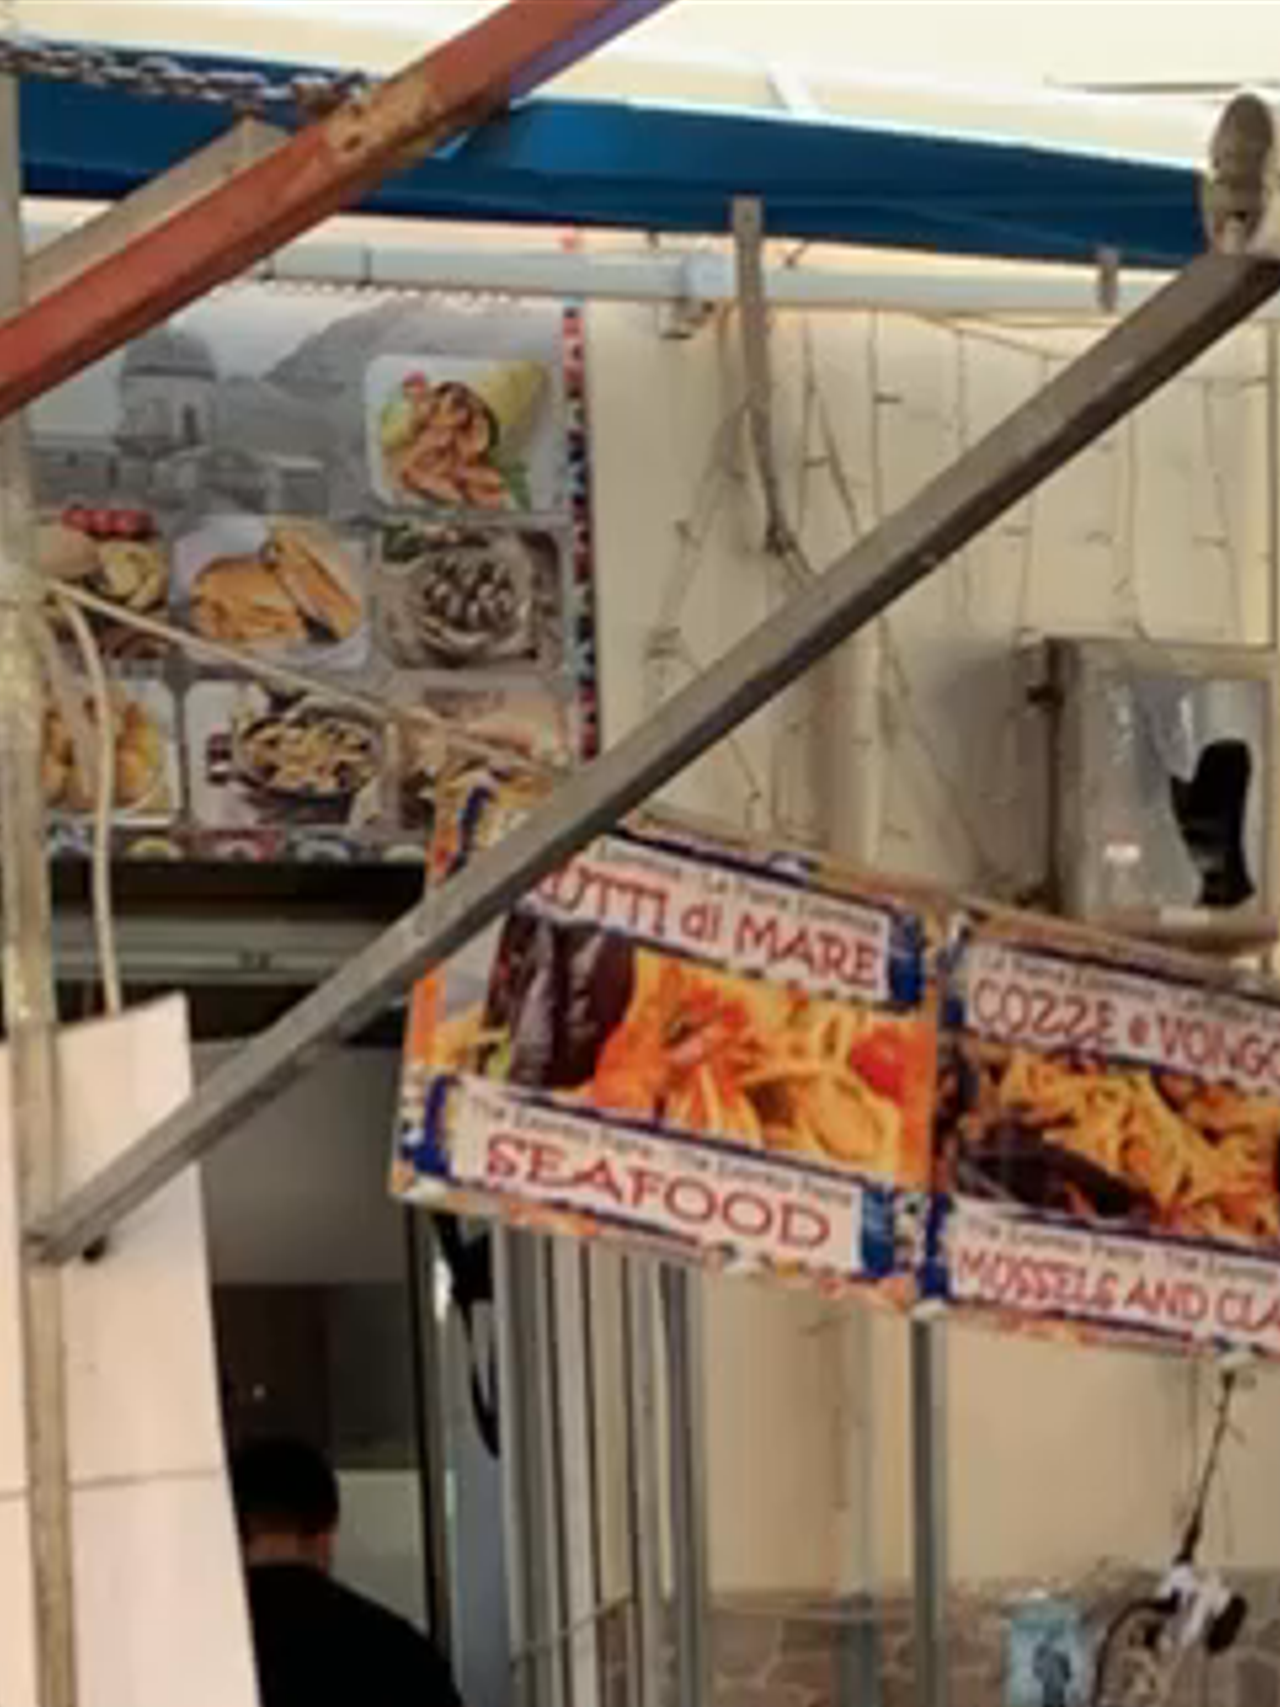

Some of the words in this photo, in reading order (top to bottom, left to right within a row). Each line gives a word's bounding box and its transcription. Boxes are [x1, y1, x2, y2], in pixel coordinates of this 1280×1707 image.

[680, 899, 721, 944] di
[733, 908, 881, 989] MARE
[972, 976, 1119, 1048] COZZE
[485, 1130, 832, 1250] SEAFOOD
[957, 1244, 1120, 1312] MUSSELS
[1123, 1276, 1208, 1323] AND
